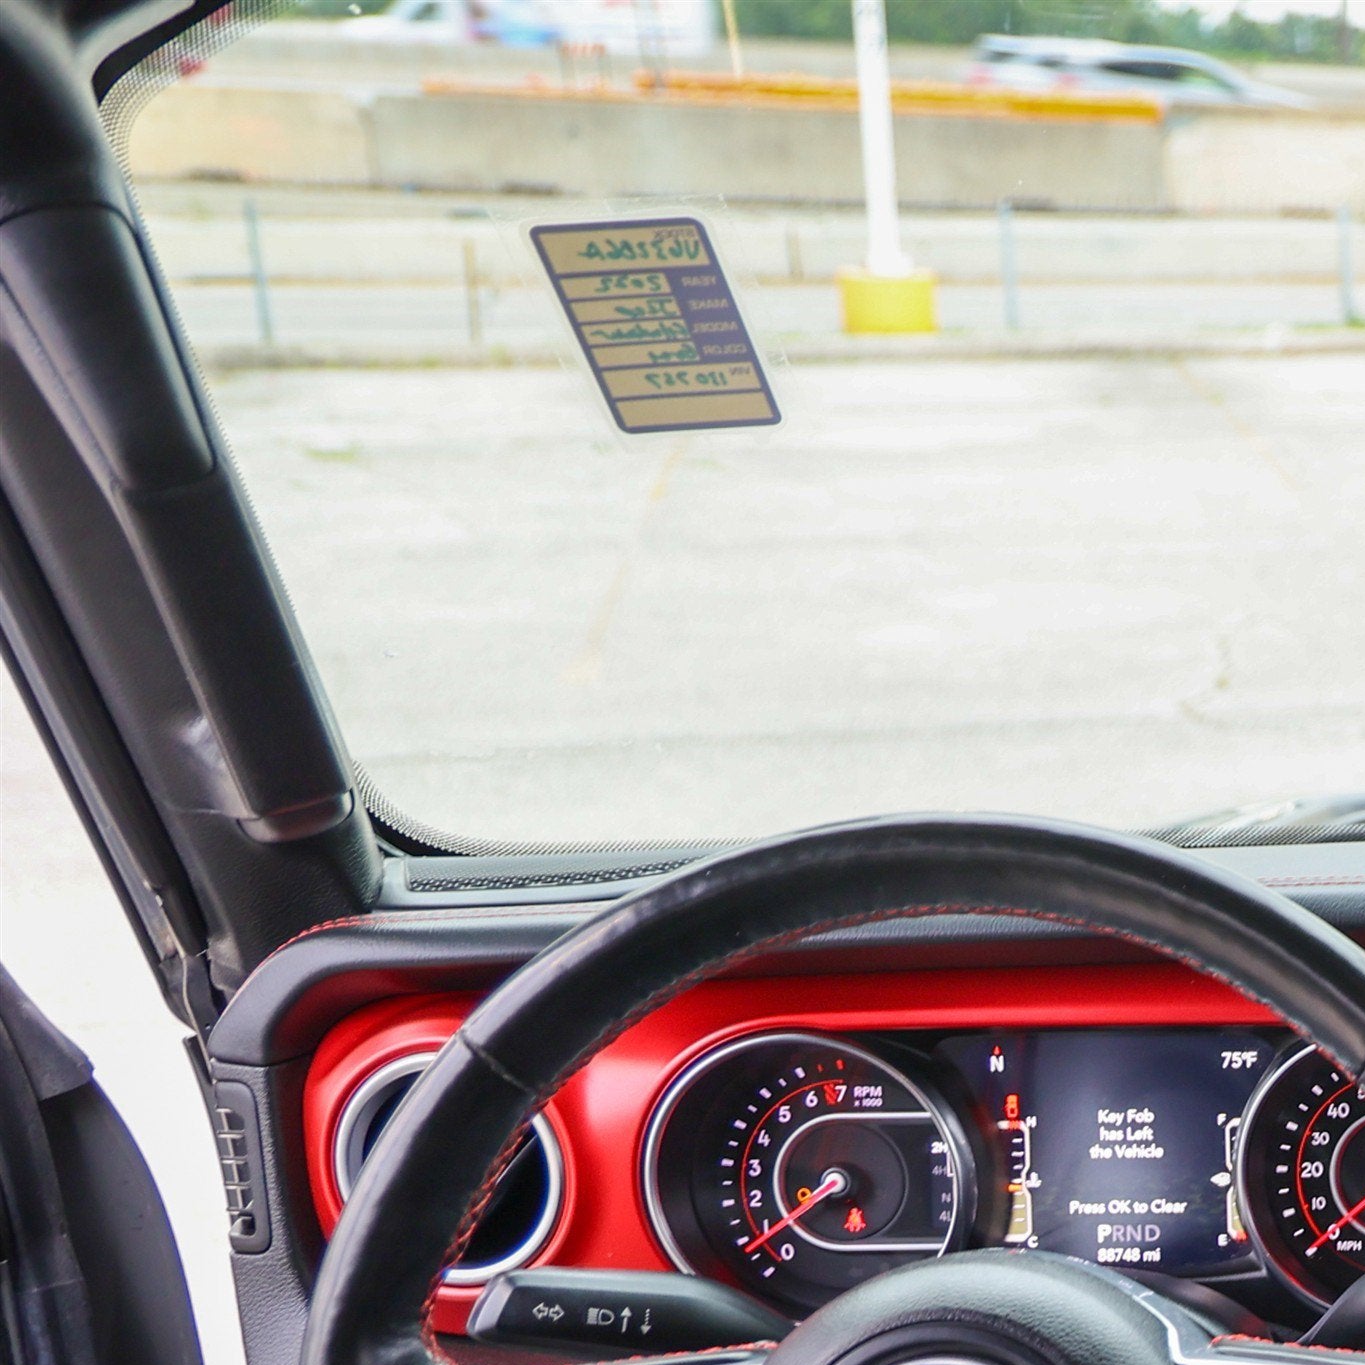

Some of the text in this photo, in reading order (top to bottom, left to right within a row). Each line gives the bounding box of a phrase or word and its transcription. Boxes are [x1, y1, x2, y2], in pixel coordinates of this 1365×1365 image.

[989, 1055, 1005, 1073] N
[805, 1090, 818, 1108] 6
[834, 1085, 847, 1103] 7
[853, 1086, 883, 1098] RPM
[778, 1105, 791, 1123] 5
[1097, 1108, 1155, 1125] Key Fob
[1327, 1102, 1350, 1119] 40
[757, 1129, 771, 1147] 4
[1099, 1126, 1154, 1142] has Left
[1311, 1132, 1330, 1146] 30
[1088, 1144, 1165, 1160] the Vehicle
[748, 1159, 762, 1178] 3
[1300, 1161, 1324, 1177] 20
[749, 1190, 763, 1208] 2
[1069, 1200, 1188, 1215] Press OK to Clear
[1311, 1197, 1327, 1210] 10
[780, 1243, 795, 1261] 0
[1336, 1240, 1363, 1251] MPH
[1143, 1247, 1162, 1262] mi
